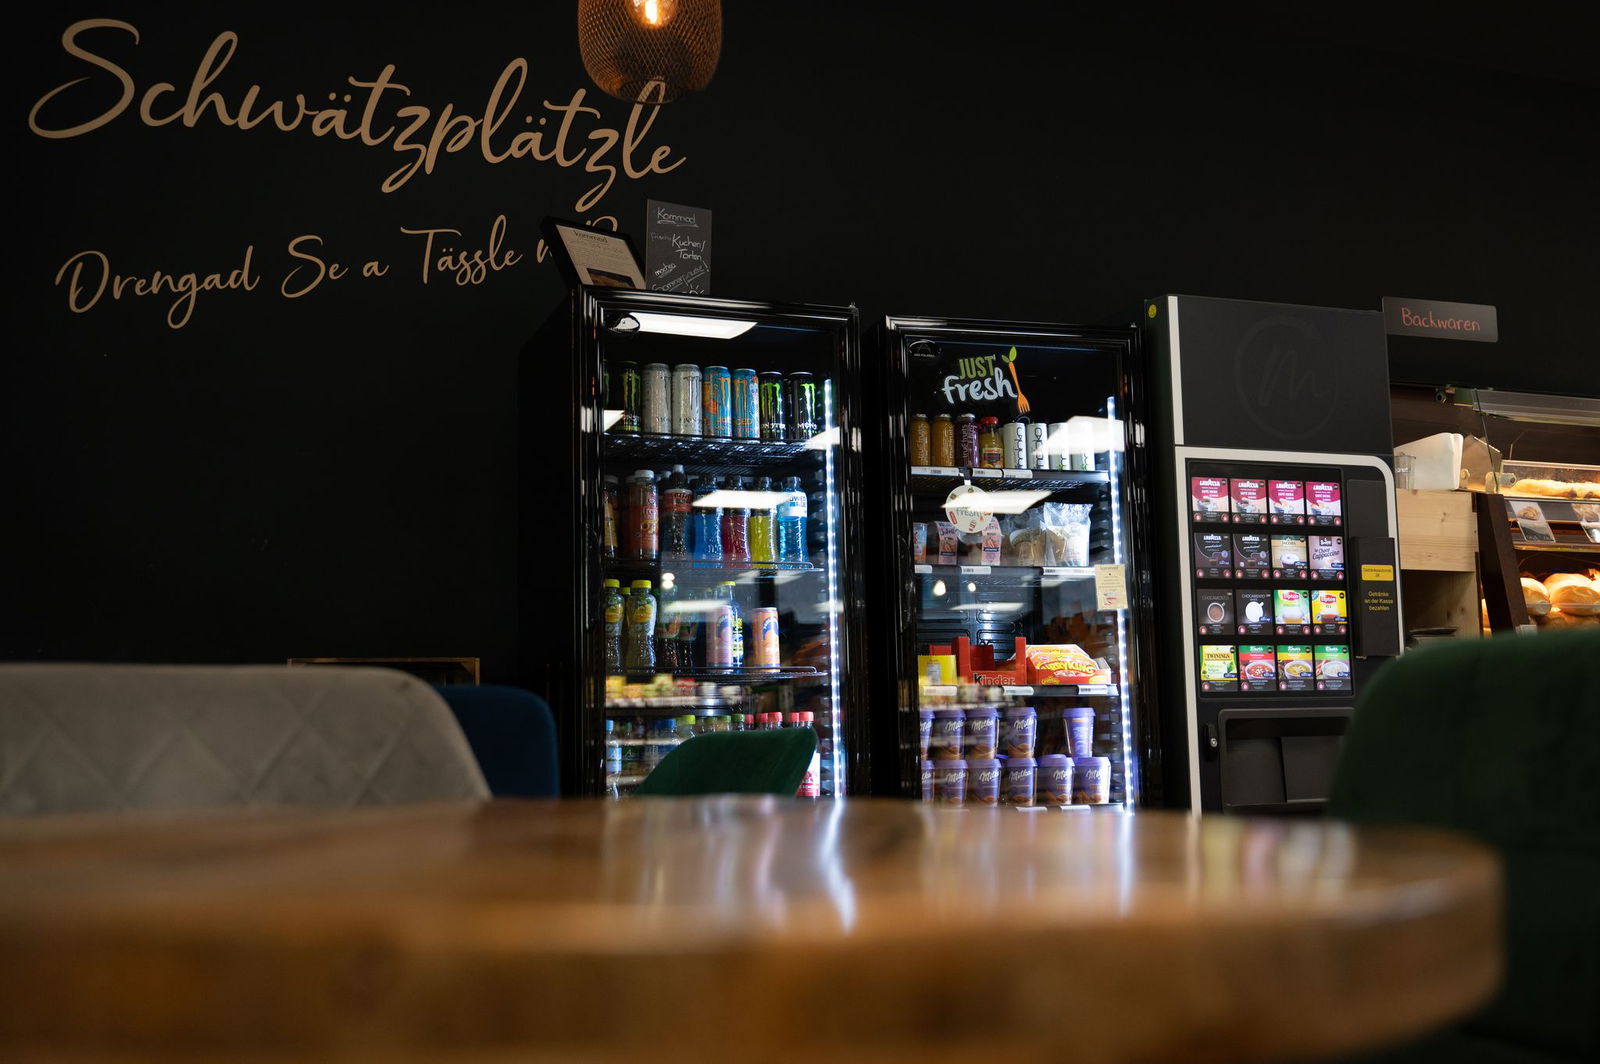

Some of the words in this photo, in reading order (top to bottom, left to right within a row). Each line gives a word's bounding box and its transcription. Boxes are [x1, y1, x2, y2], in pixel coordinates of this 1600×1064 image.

[27, 18, 687, 212] Schwätzplätzle
[657, 207, 697, 224] Kommod
[675, 247, 702, 261] Torten
[54, 245, 260, 329] Drengad
[280, 234, 347, 299] Se
[361, 257, 390, 278] a
[400, 214, 523, 286] Tässle
[1401, 307, 1481, 332] Backwaren
[959, 355, 995, 380] JUST
[942, 367, 1017, 405] fresh
